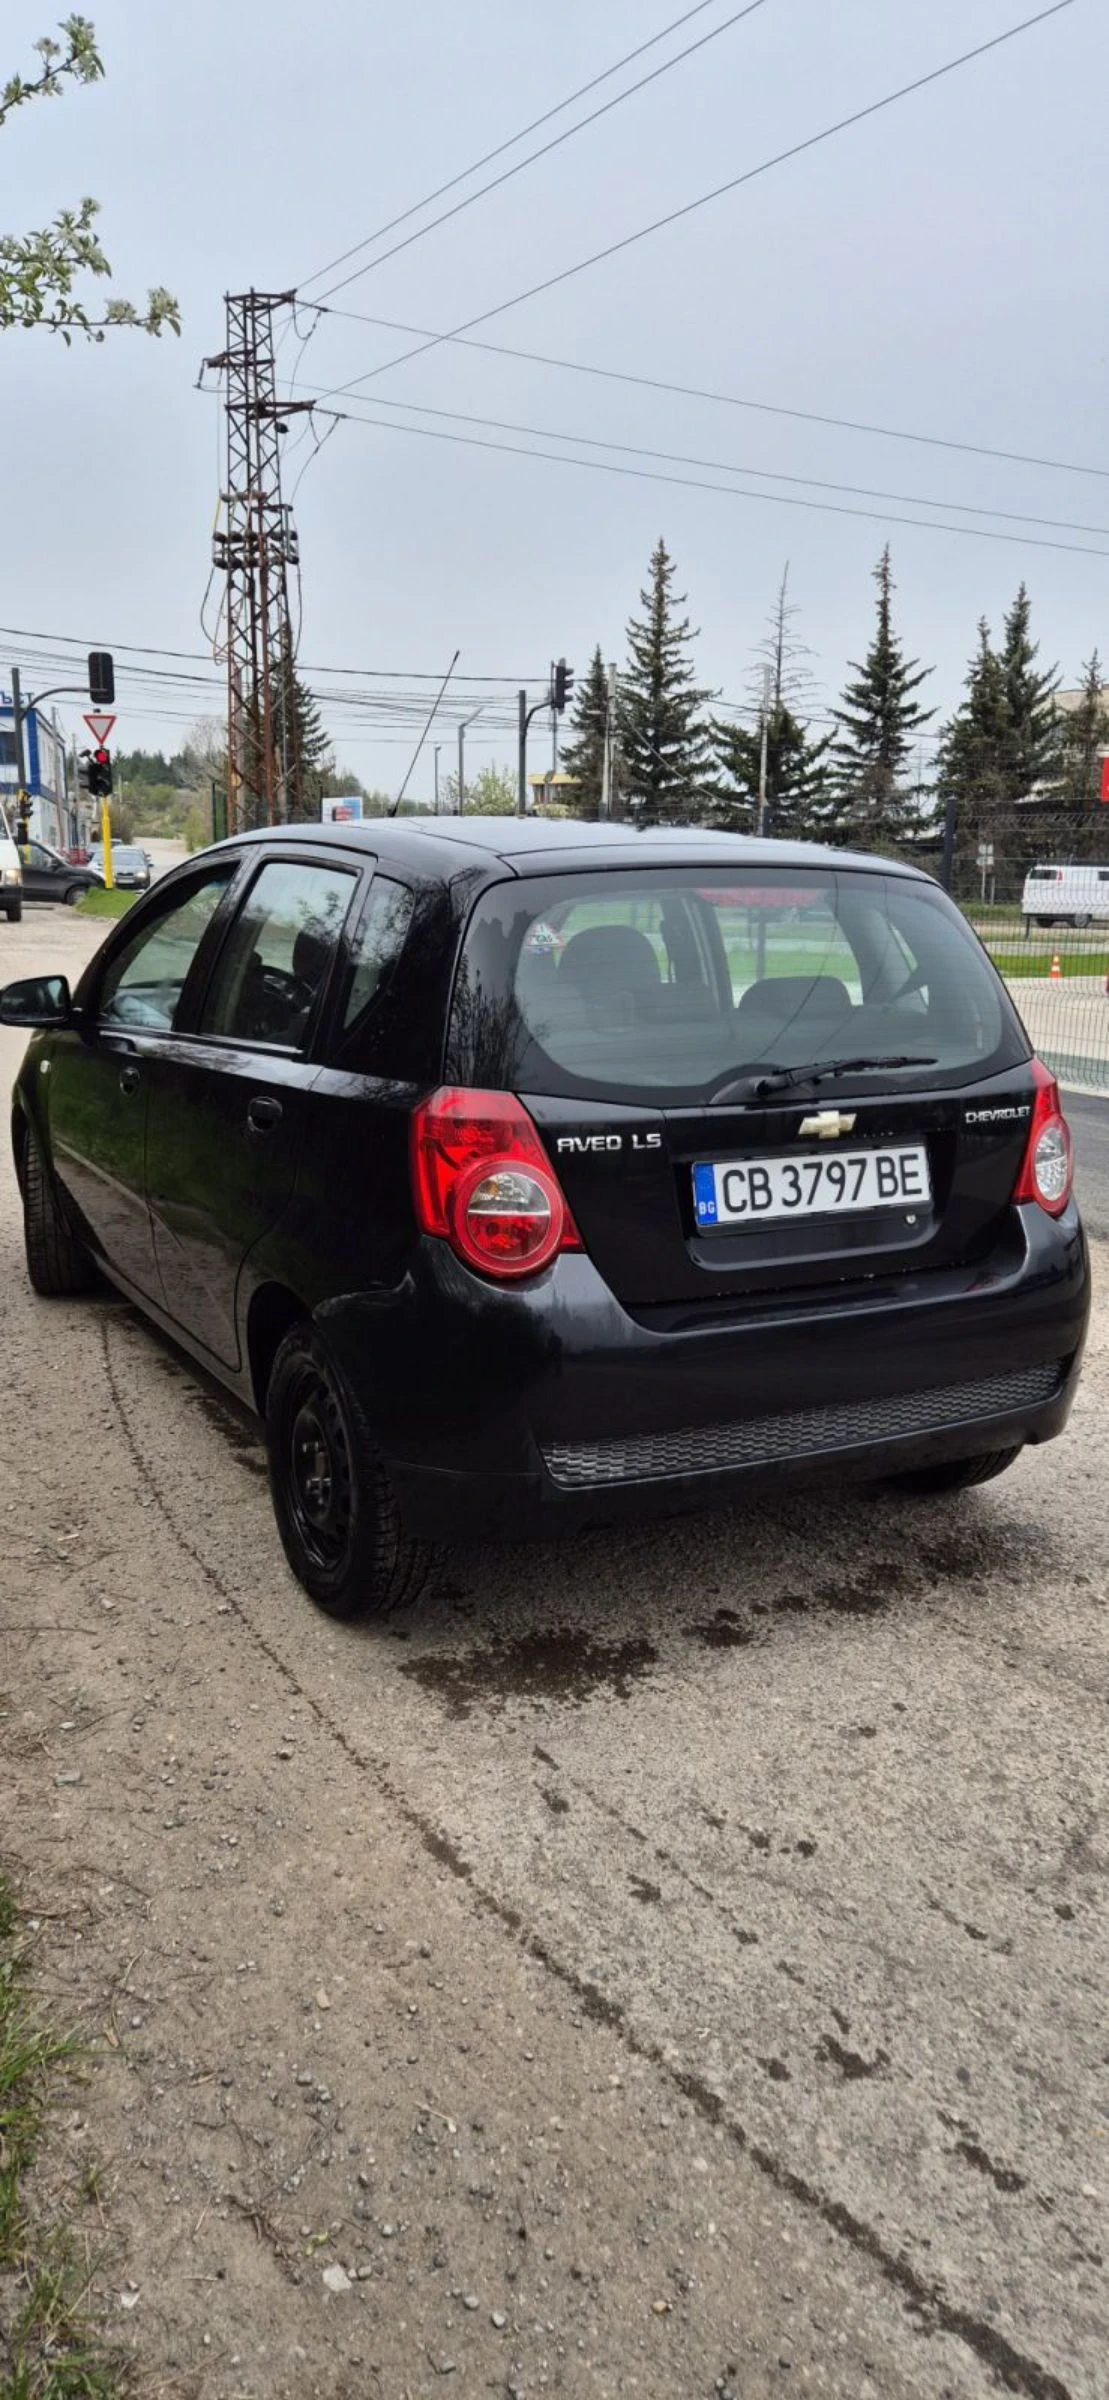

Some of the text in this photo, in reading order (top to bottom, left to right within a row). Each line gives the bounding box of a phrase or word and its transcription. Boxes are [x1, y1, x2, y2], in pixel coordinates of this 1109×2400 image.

[965, 1106, 1030, 1124] CHEVROLET
[557, 1133, 662, 1152] AVEO LS
[722, 1154, 922, 1213] CB 3797 BE
[698, 1201, 715, 1215] BG
